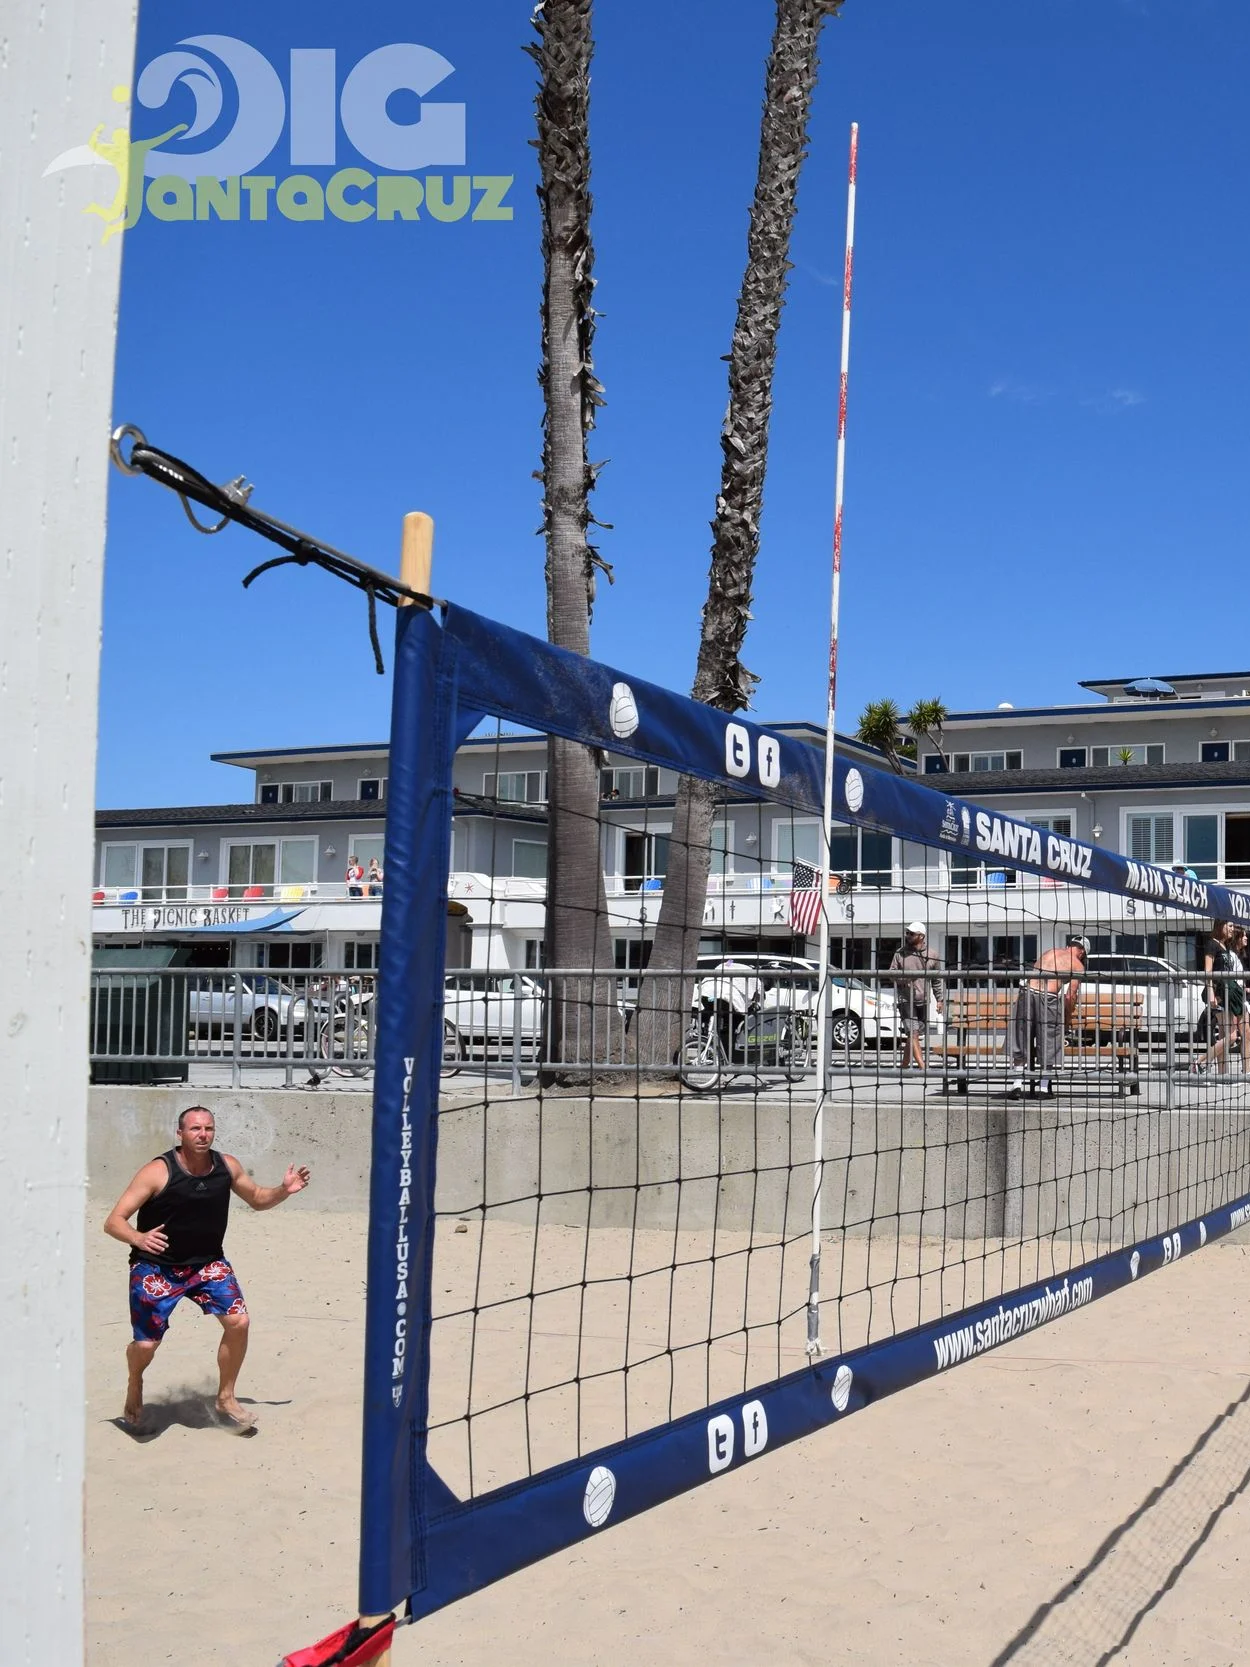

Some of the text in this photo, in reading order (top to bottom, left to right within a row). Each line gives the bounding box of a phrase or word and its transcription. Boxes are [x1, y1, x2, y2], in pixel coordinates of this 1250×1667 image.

[976, 811, 1093, 879] SANTA CRUZ
[1125, 860, 1164, 897] MAIN
[1166, 874, 1208, 909] BEACH
[122, 907, 250, 929] THE PICNIC BASKET
[933, 1276, 1093, 1370] www.santacruzwharf.com
